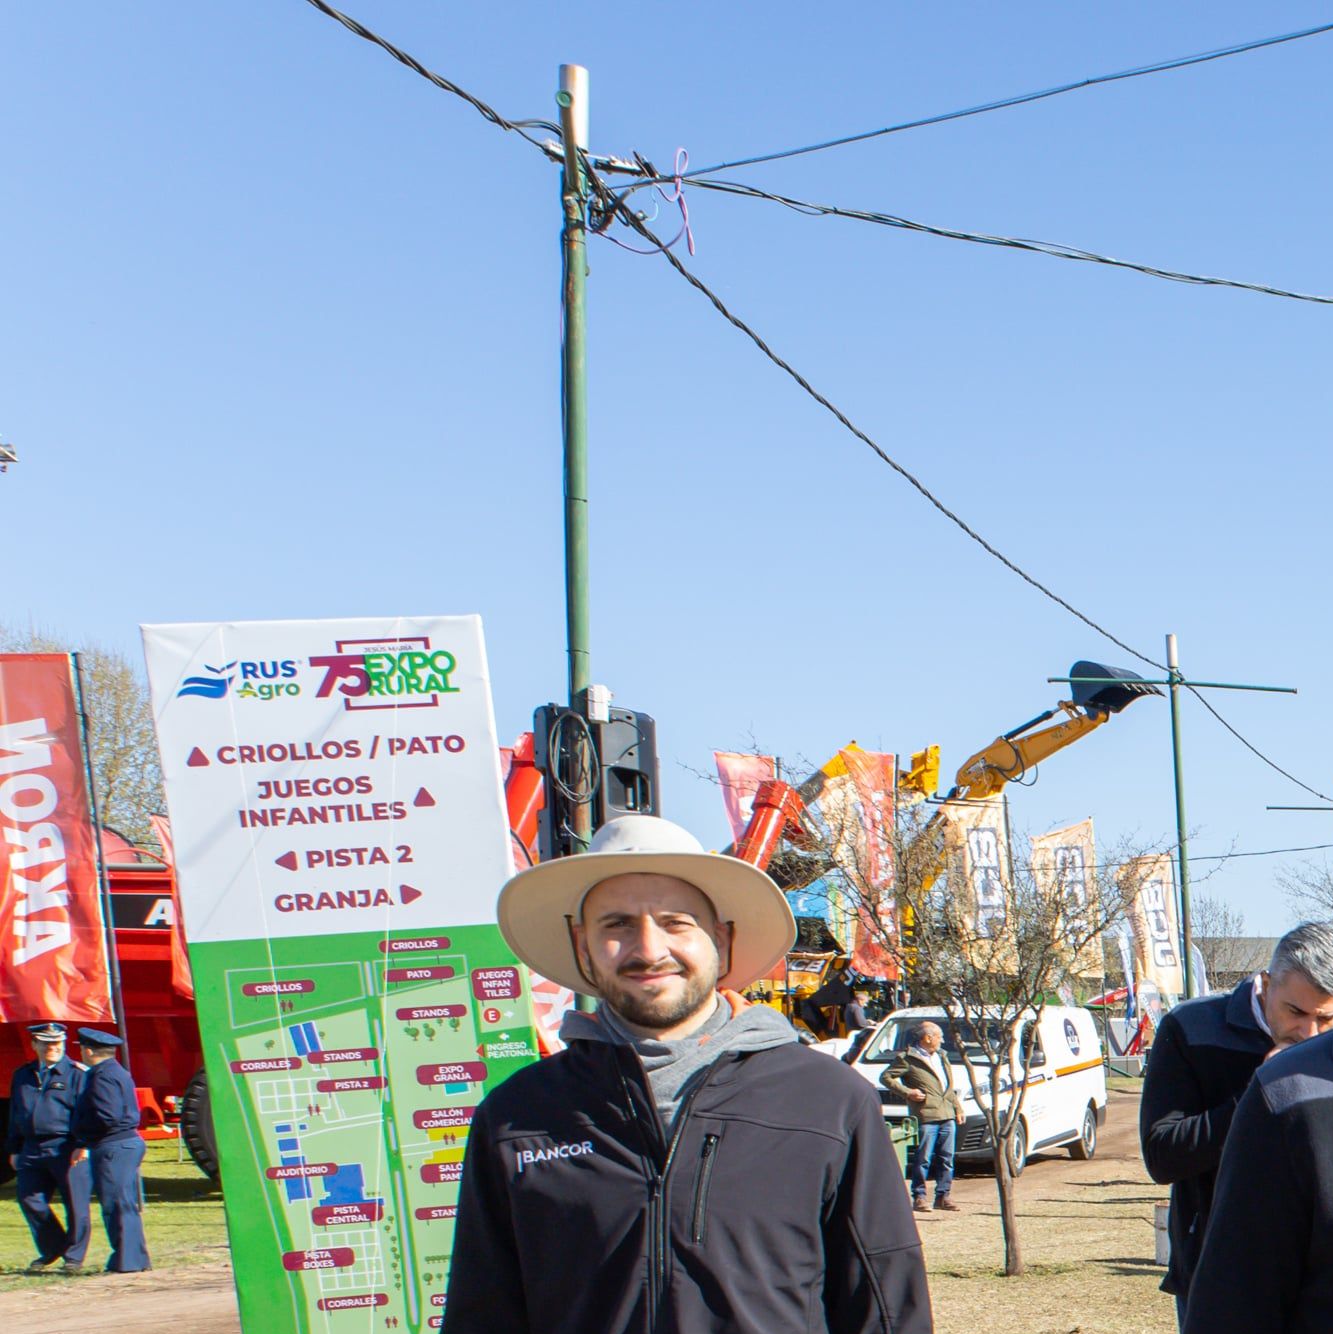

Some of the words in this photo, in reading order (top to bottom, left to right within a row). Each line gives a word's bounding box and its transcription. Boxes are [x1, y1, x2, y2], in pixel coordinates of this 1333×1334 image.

[365, 651, 456, 675] EXPO
[240, 660, 297, 680] RUS
[309, 655, 372, 698] 75
[368, 673, 460, 696] RURAL
[237, 682, 301, 700] Agro
[217, 739, 362, 764] CRIOLLOS
[388, 734, 465, 756] PATO
[257, 775, 373, 800] JUEGOS
[238, 801, 408, 828] INFANTILES
[306, 847, 390, 869] PISTA
[395, 845, 413, 864] 2
[274, 888, 394, 912] GRANJA
[392, 939, 438, 950] CRIOLLOS
[407, 969, 431, 979] PATO
[477, 971, 514, 979] JUEGOS
[255, 983, 302, 994] CRIOLLOS
[482, 980, 511, 988] INFAN
[485, 989, 511, 997] TILES
[412, 1008, 449, 1018] STANDS
[488, 1010, 497, 1020] E
[487, 1042, 527, 1051] INGRESO
[323, 1051, 362, 1061] STANDS
[488, 1049, 536, 1058] PEATONAL
[241, 1060, 291, 1072] CORRALES
[438, 1065, 464, 1075] EXPO
[433, 1071, 472, 1082] GRANJA
[335, 1081, 359, 1090] PISTA
[362, 1080, 369, 1088] 2
[432, 1108, 463, 1118] SALÓN
[521, 1141, 594, 1164] BANCOR
[276, 1166, 329, 1177] AUDITORIO
[439, 1163, 463, 1172] SALO
[333, 1206, 361, 1215] PISTA
[432, 1209, 457, 1218] STAN
[326, 1214, 370, 1224] CENTRAL
[304, 1251, 332, 1260] PISTA
[304, 1260, 335, 1269] BOXES
[328, 1297, 378, 1308] CORRALES
